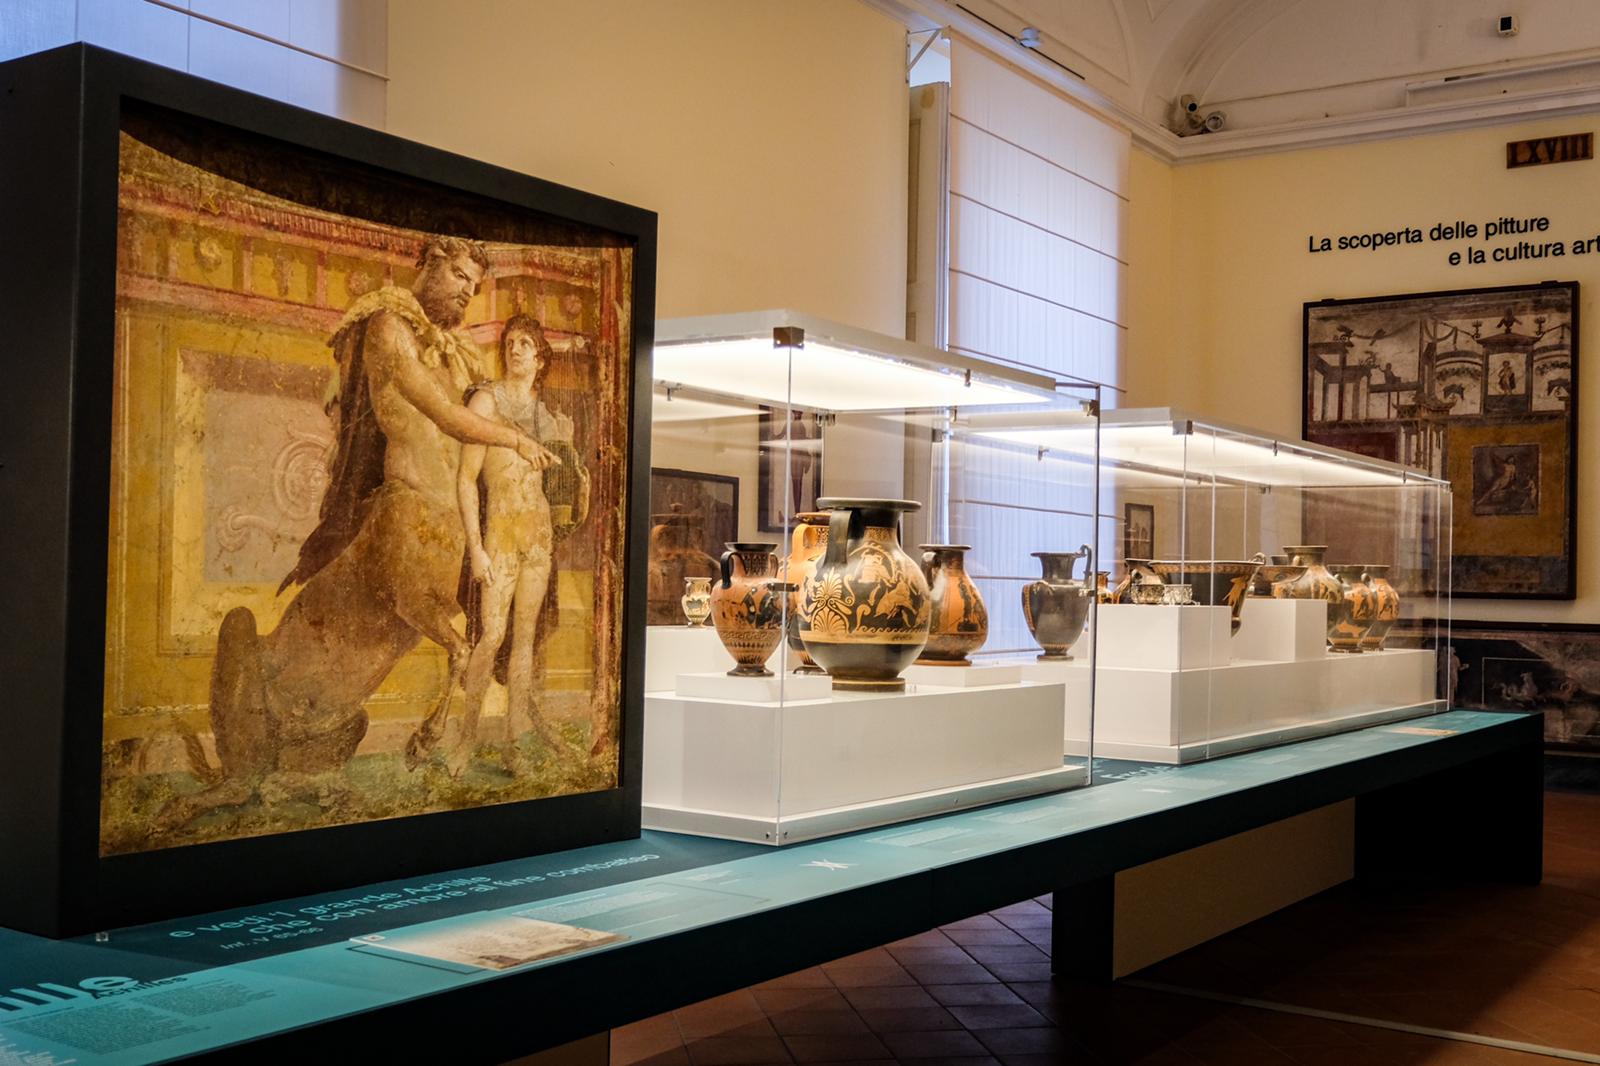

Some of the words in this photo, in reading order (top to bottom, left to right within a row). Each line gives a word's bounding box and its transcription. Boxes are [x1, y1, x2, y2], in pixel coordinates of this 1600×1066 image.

[1509, 133, 1590, 168] LXVIII
[1309, 235, 1332, 253] La
[1338, 227, 1423, 250] scoperta
[1429, 221, 1478, 241] delle
[1485, 217, 1549, 240] pitture
[1448, 252, 1461, 265] e
[1468, 247, 1486, 264] la
[1492, 241, 1566, 262] cultura
[169, 930, 195, 938] e
[197, 915, 273, 932] vedi
[299, 892, 403, 915] grande
[402, 876, 492, 895] Achille
[249, 919, 312, 934] che
[316, 907, 376, 922] con
[377, 890, 468, 910] amore
[469, 884, 499, 893] al
[493, 875, 546, 887] fine
[90, 977, 188, 1000] Achilles
